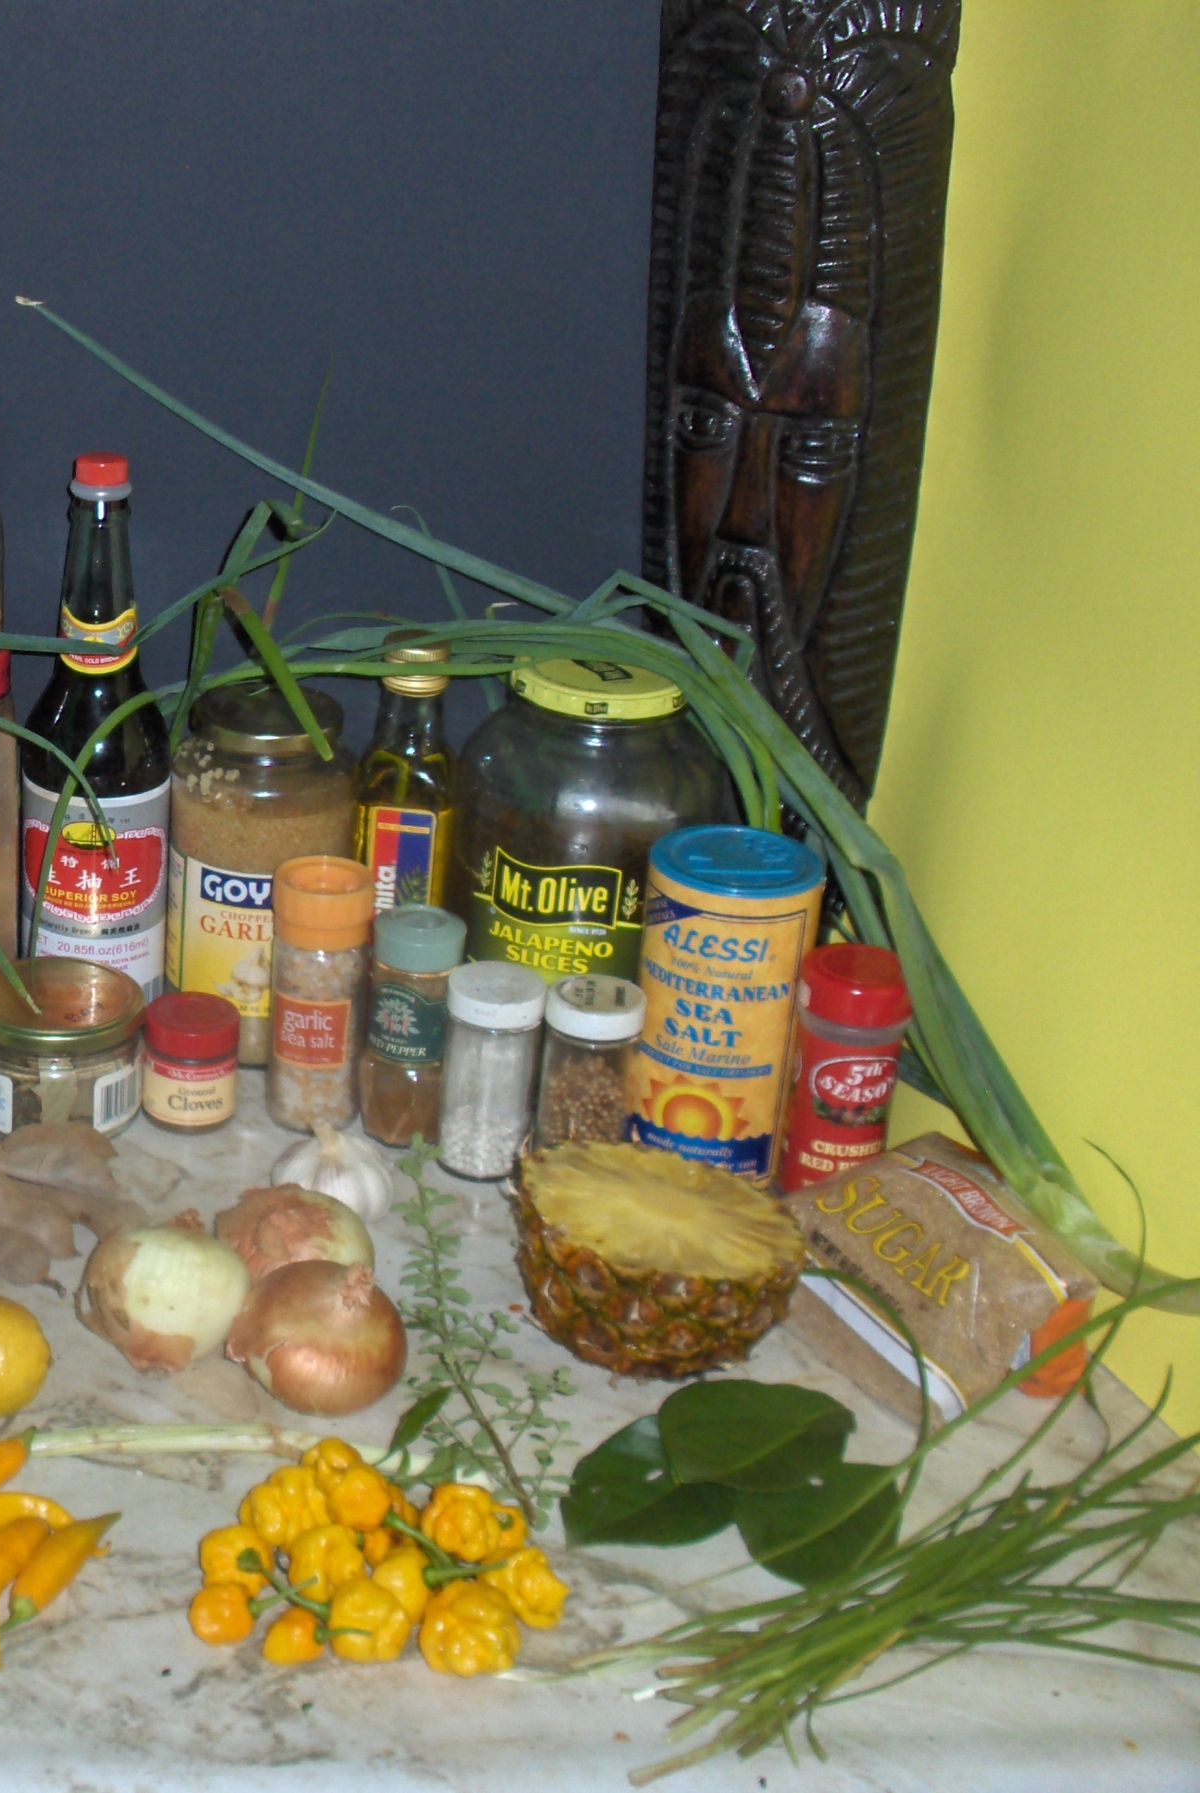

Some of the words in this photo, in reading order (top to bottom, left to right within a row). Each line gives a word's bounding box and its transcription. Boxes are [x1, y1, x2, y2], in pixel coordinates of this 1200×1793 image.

[111, 889, 137, 902] SOY
[203, 873, 271, 905] GOY
[500, 864, 533, 912] Mt.
[537, 876, 609, 914] Olive
[200, 914, 272, 942] GARL
[489, 920, 614, 958] JALAPENO
[663, 924, 769, 963] ALESSI
[506, 944, 590, 975] SLICES
[705, 965, 754, 981] Natural
[282, 1008, 334, 1033] garlic
[675, 998, 734, 1026] SEA
[279, 1030, 306, 1048] sea
[308, 1033, 336, 1049] salt
[664, 1016, 744, 1048] SALT
[386, 1043, 427, 1057] PEPPER
[688, 1047, 753, 1066] Marino
[167, 1094, 225, 1112] Cloves
[178, 1085, 216, 1097] Ground
[646, 1132, 675, 1149] made
[678, 1143, 735, 1159] naturally
[800, 1150, 836, 1173] RED
[960, 1189, 1011, 1228] BROWN
[816, 1175, 971, 1307] SUGAR
